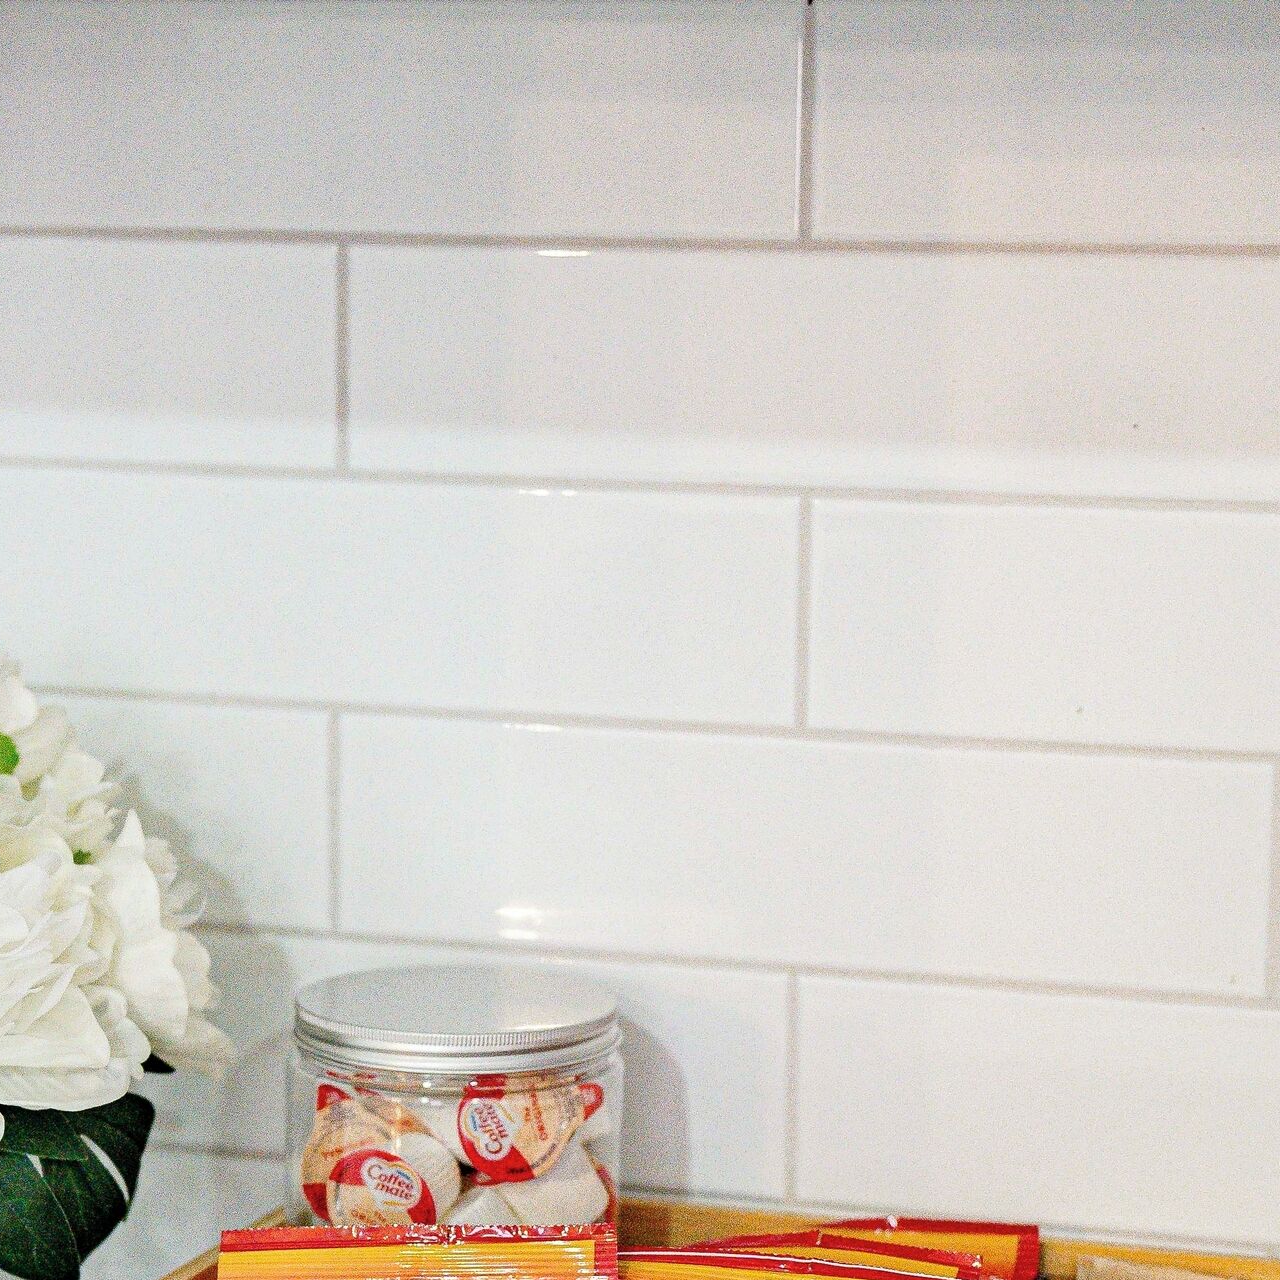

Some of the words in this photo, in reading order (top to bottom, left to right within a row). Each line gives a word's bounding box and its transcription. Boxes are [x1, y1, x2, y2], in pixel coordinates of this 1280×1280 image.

[475, 1104, 503, 1154] Coffee
[483, 1101, 509, 1139] mate
[367, 1164, 414, 1191] Coffee
[375, 1182, 414, 1201] mate
